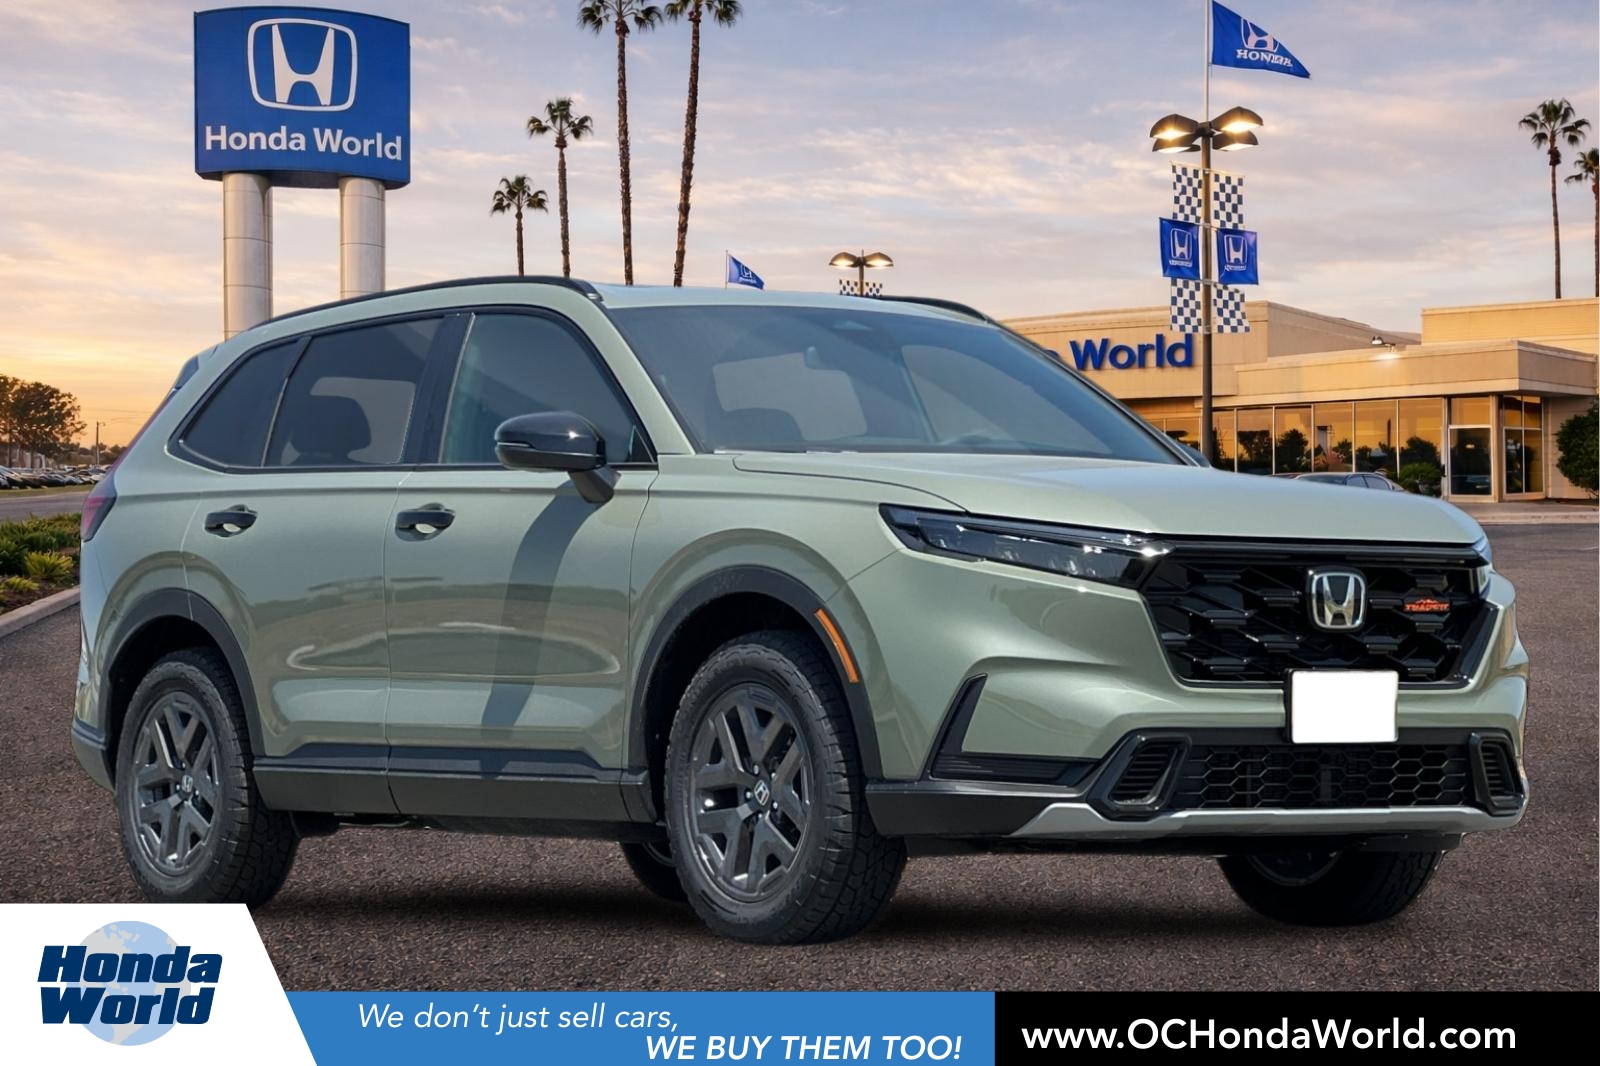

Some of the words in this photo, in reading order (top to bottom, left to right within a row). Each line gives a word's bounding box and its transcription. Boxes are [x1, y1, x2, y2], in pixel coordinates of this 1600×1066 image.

[205, 125, 306, 151] Honda
[313, 128, 402, 160] World
[1069, 333, 1193, 371] World
